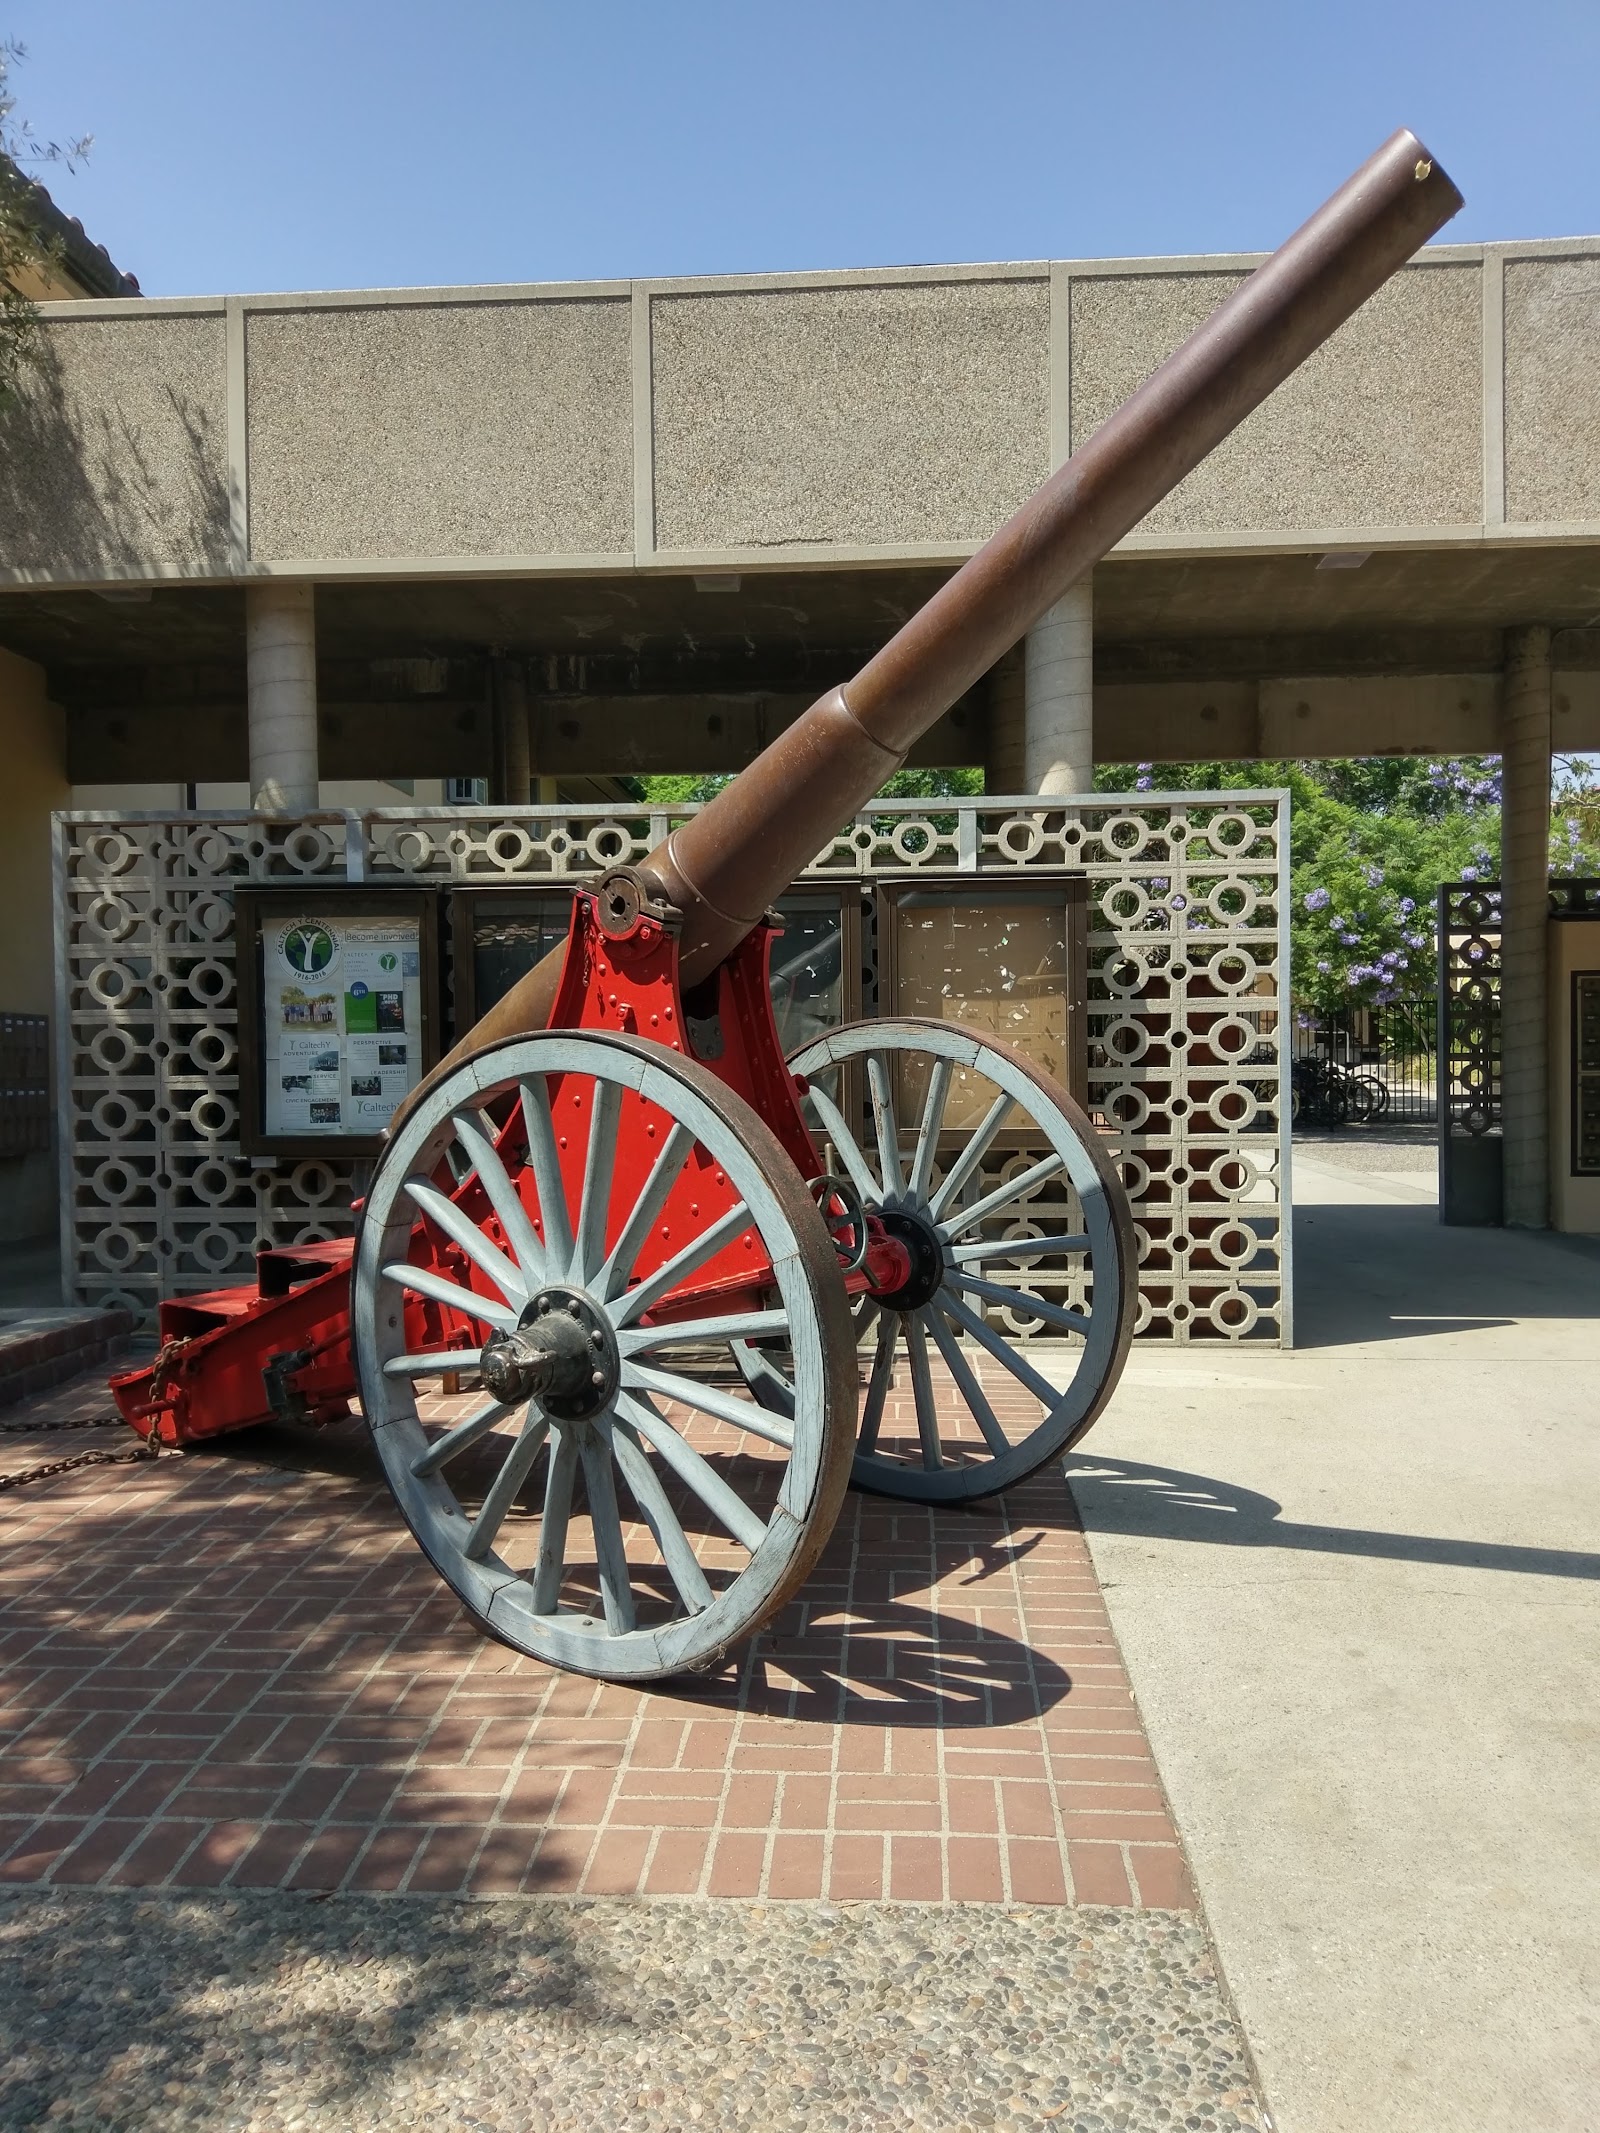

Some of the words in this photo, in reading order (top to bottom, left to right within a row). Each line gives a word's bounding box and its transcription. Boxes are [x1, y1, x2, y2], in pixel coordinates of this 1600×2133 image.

[277, 921, 297, 955] CALTECH
[304, 917, 340, 953] CENTENNIAL
[346, 933, 379, 941] Become
[381, 932, 419, 941] involved!
[293, 971, 327, 981] 1916-2016
[363, 1101, 400, 1112] Caltech
